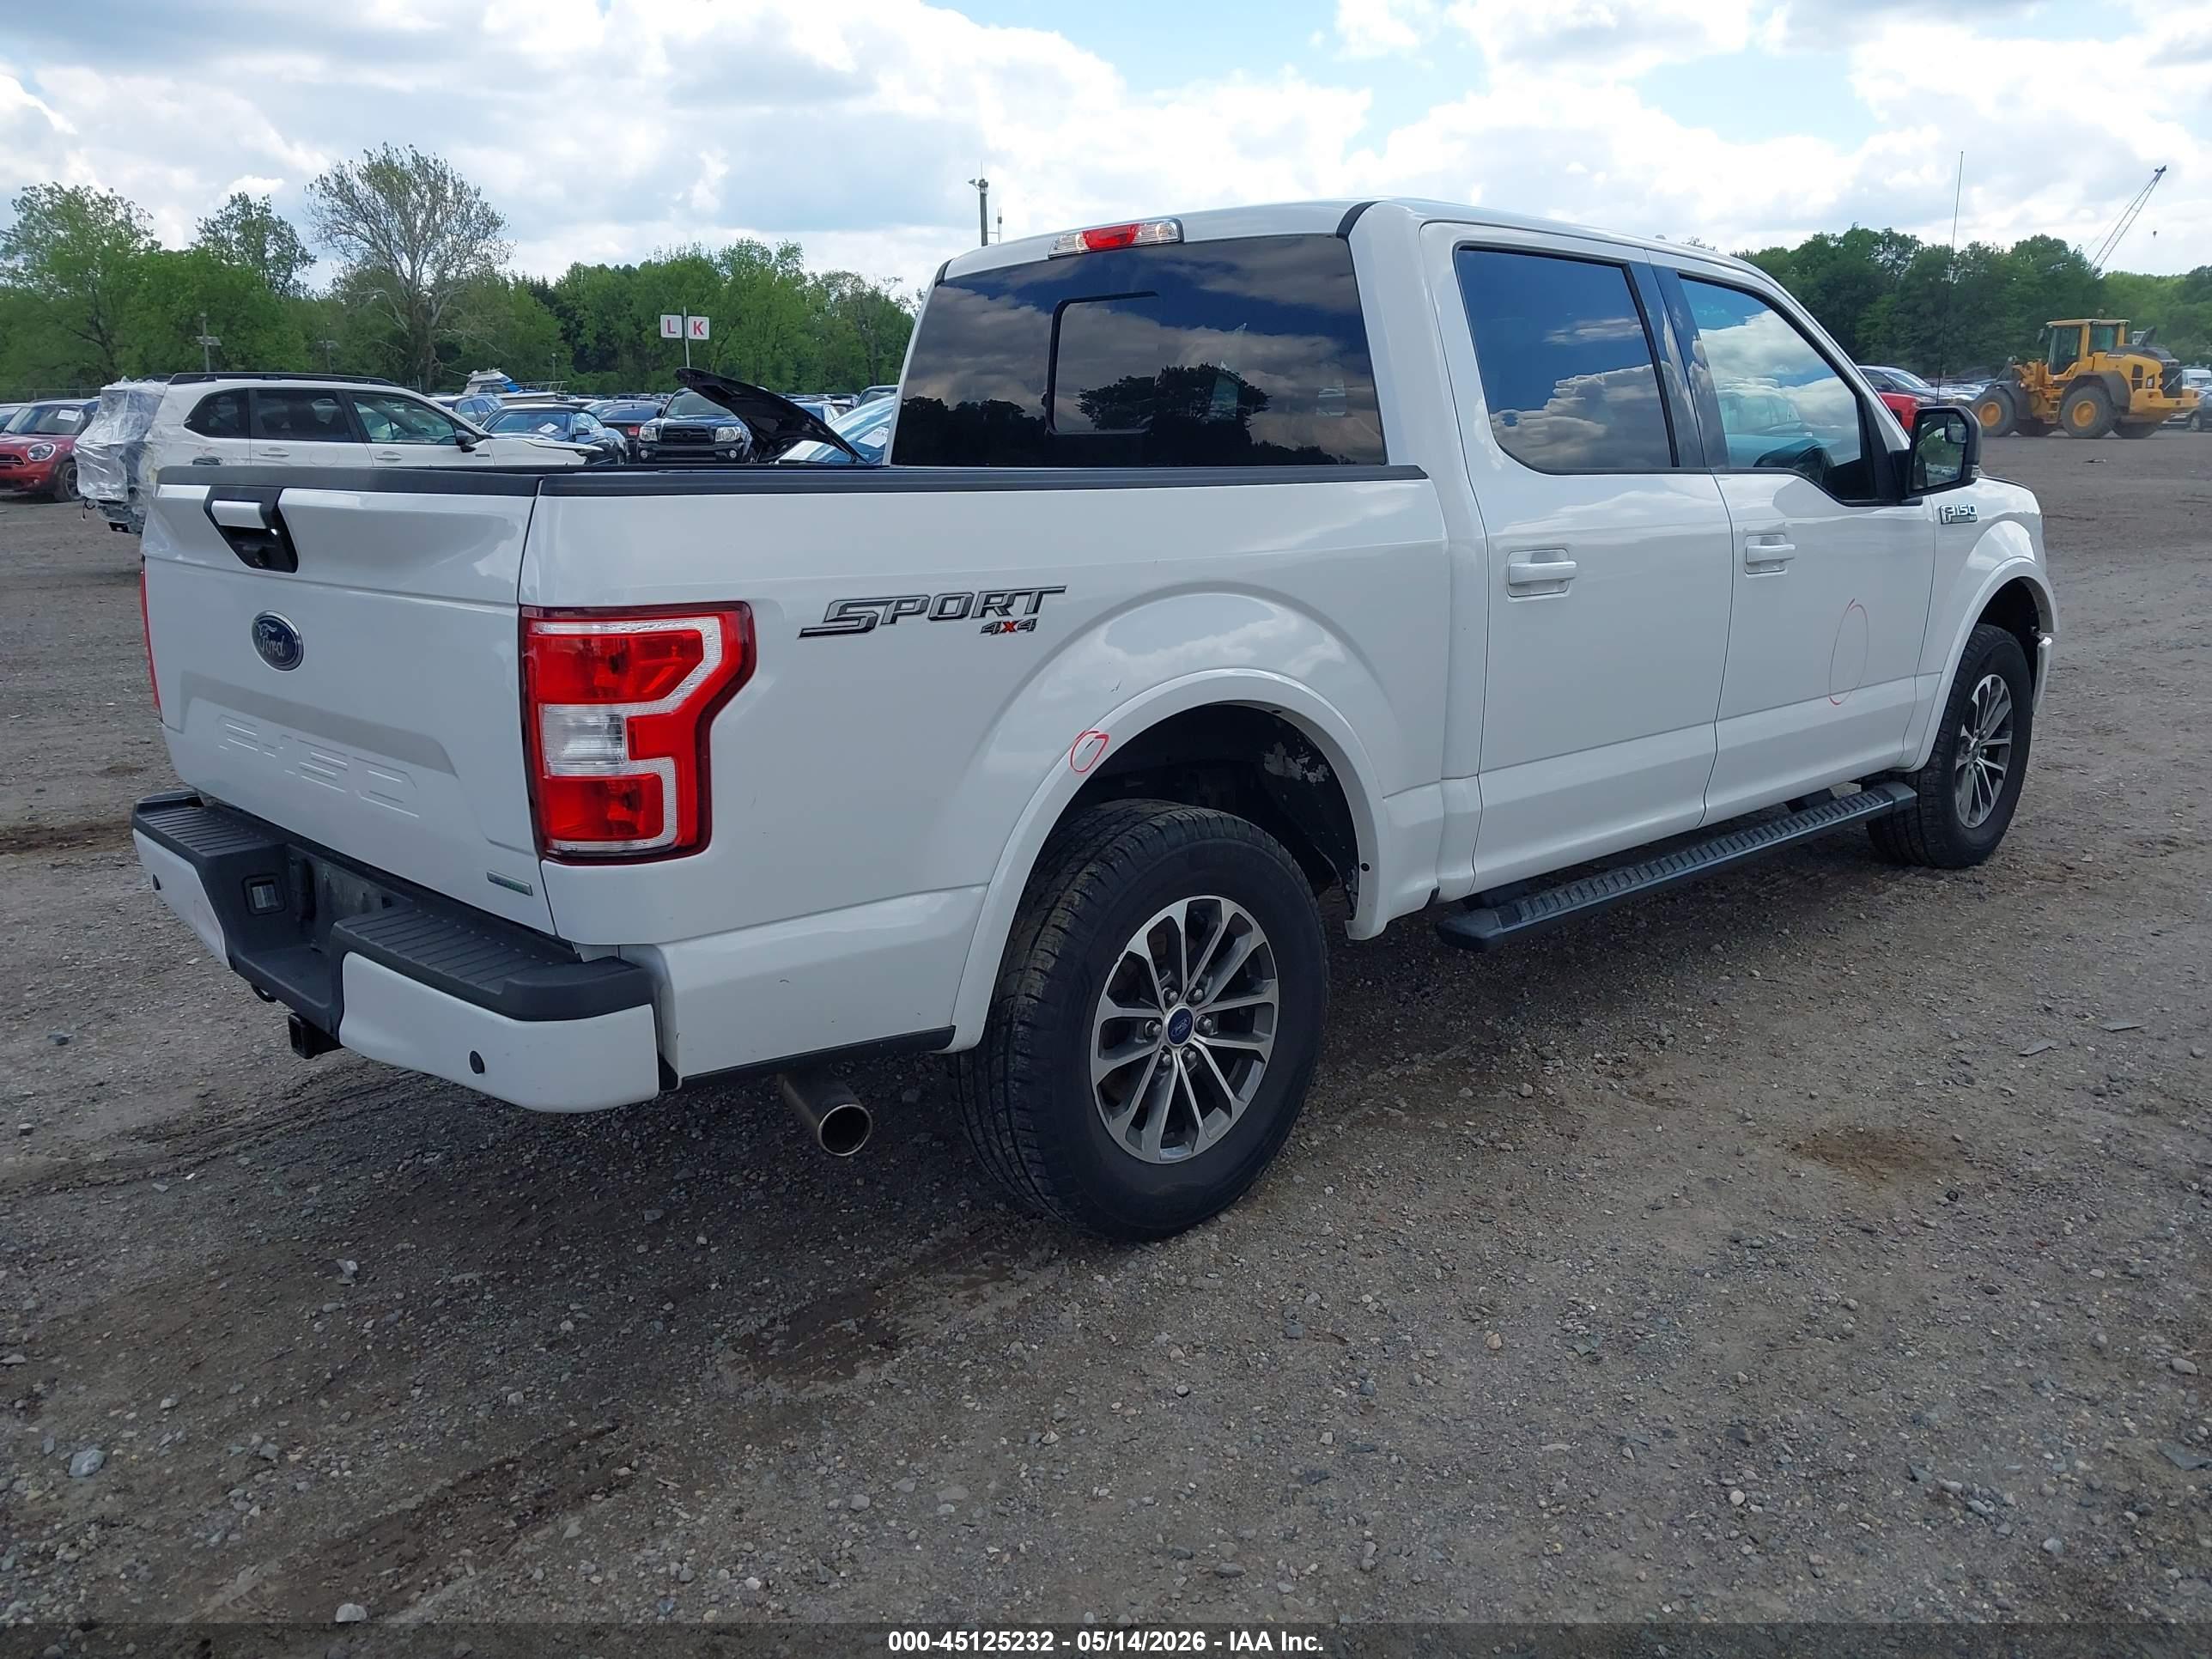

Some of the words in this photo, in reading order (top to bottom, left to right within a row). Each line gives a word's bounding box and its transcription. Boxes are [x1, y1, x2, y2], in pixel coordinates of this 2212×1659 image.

[666, 319, 677, 334] L
[693, 320, 704, 336] K
[797, 586, 1066, 639] SPORT
